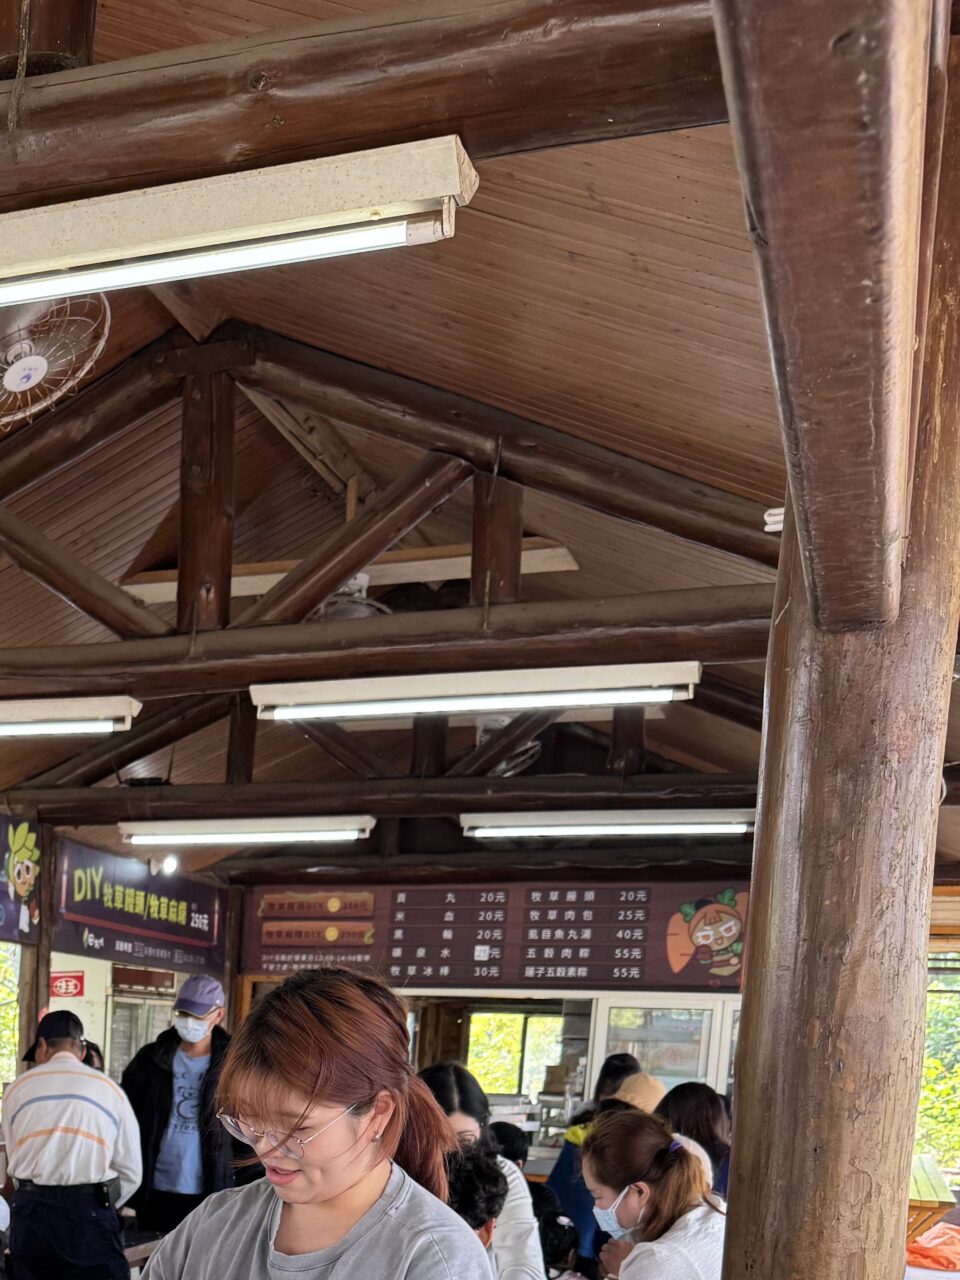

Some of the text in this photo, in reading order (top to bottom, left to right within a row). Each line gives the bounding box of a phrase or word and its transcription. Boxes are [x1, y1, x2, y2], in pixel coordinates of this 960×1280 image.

[73, 865, 103, 902] DIY
[480, 892, 506, 903] 20元
[619, 891, 647, 902] 20元
[478, 911, 504, 921] 20元
[529, 909, 645, 921] 牧草肉包 25元
[476, 929, 503, 940] 20元
[616, 929, 643, 940] 40元
[614, 948, 642, 959] 55元
[474, 966, 500, 977] 30元
[612, 967, 640, 978] 55元
